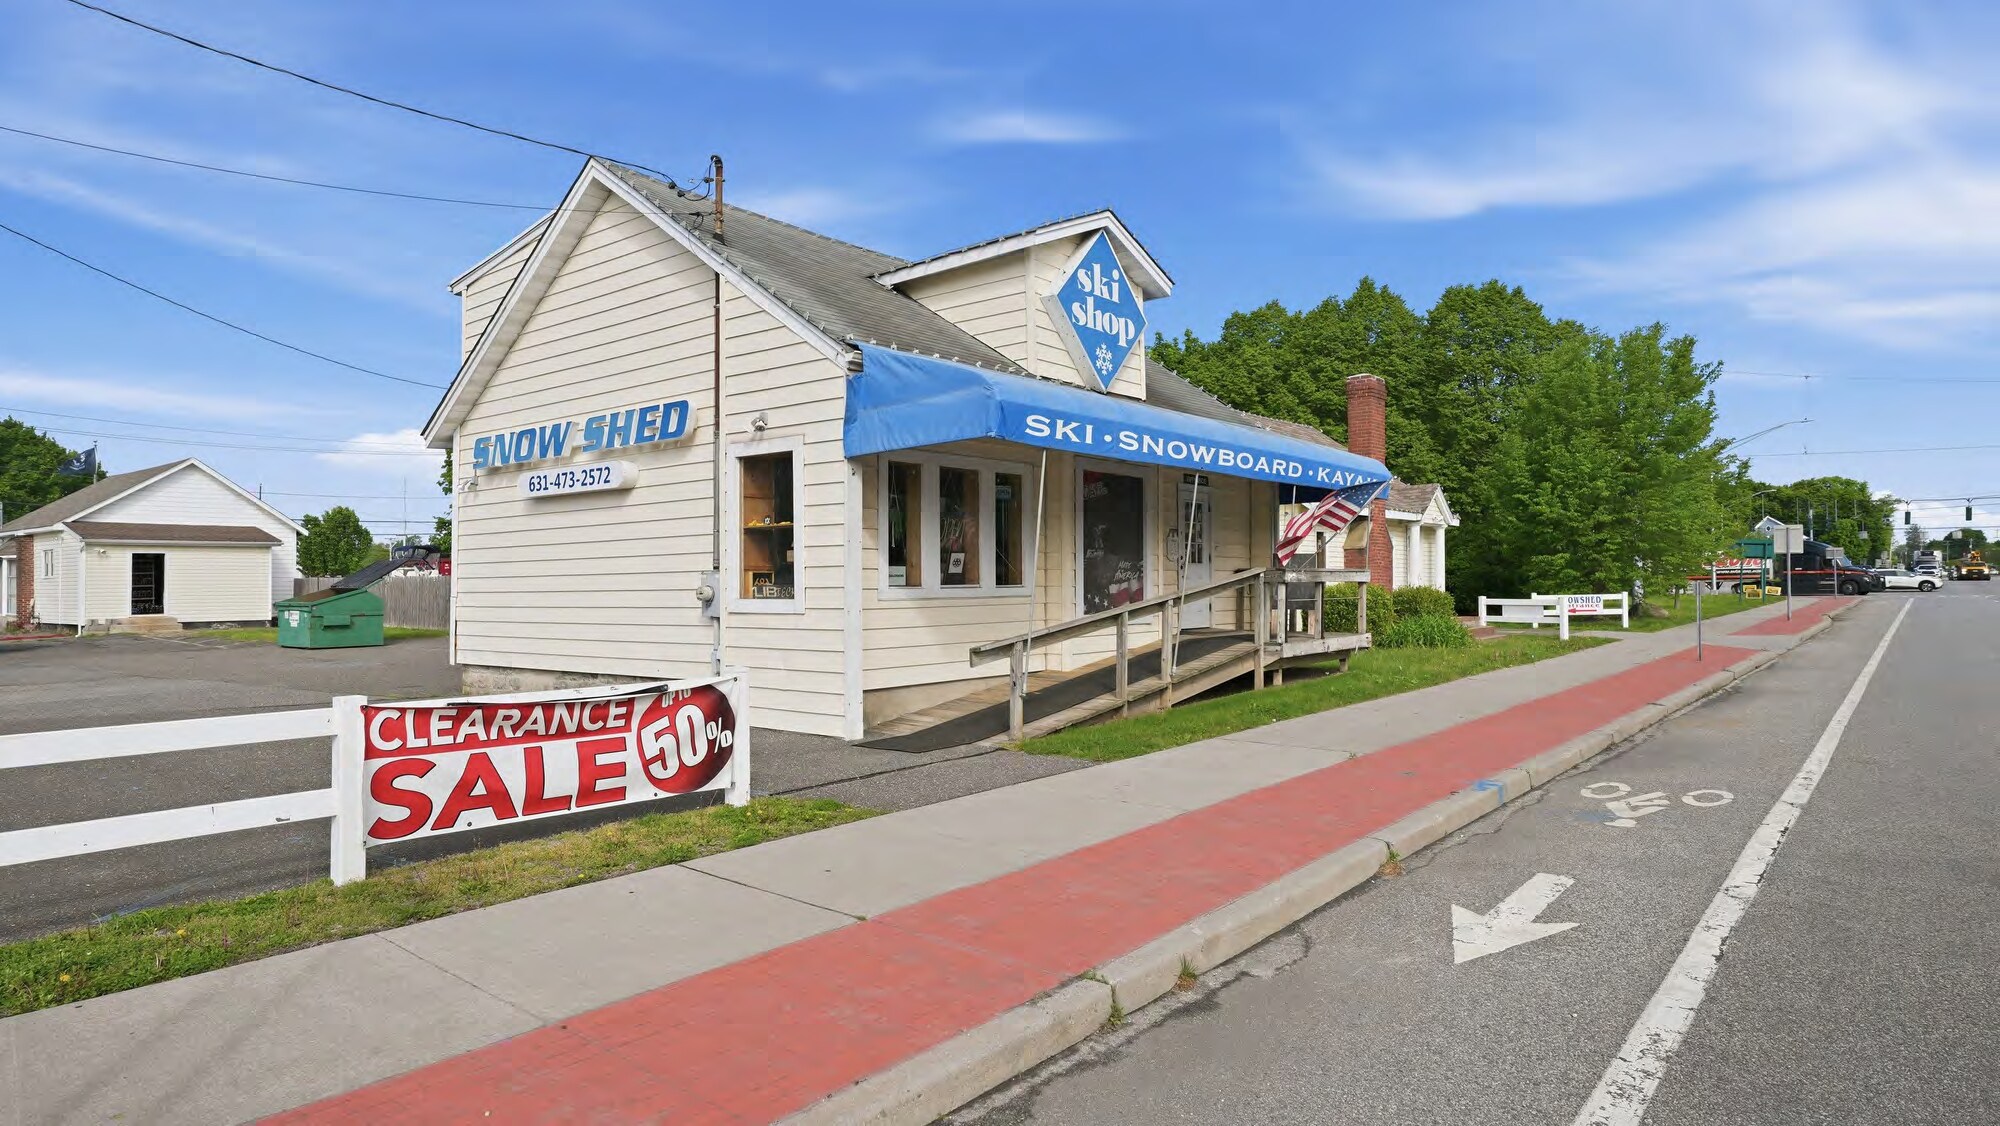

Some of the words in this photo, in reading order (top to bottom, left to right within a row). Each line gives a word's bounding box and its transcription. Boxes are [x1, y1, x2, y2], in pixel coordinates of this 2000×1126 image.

[1077, 263, 1120, 303] ski
[1071, 296, 1136, 347] shop
[473, 421, 572, 469] SNOW
[581, 400, 689, 452] SHED
[1025, 414, 1093, 444] SKI
[1118, 430, 1302, 478] SNOWBOARD
[528, 466, 611, 493] 631-473-2572
[1568, 596, 1602, 604] OWSHED
[369, 697, 628, 751] CLEARANCE
[641, 704, 733, 780] 50%
[367, 736, 627, 839] SALE
